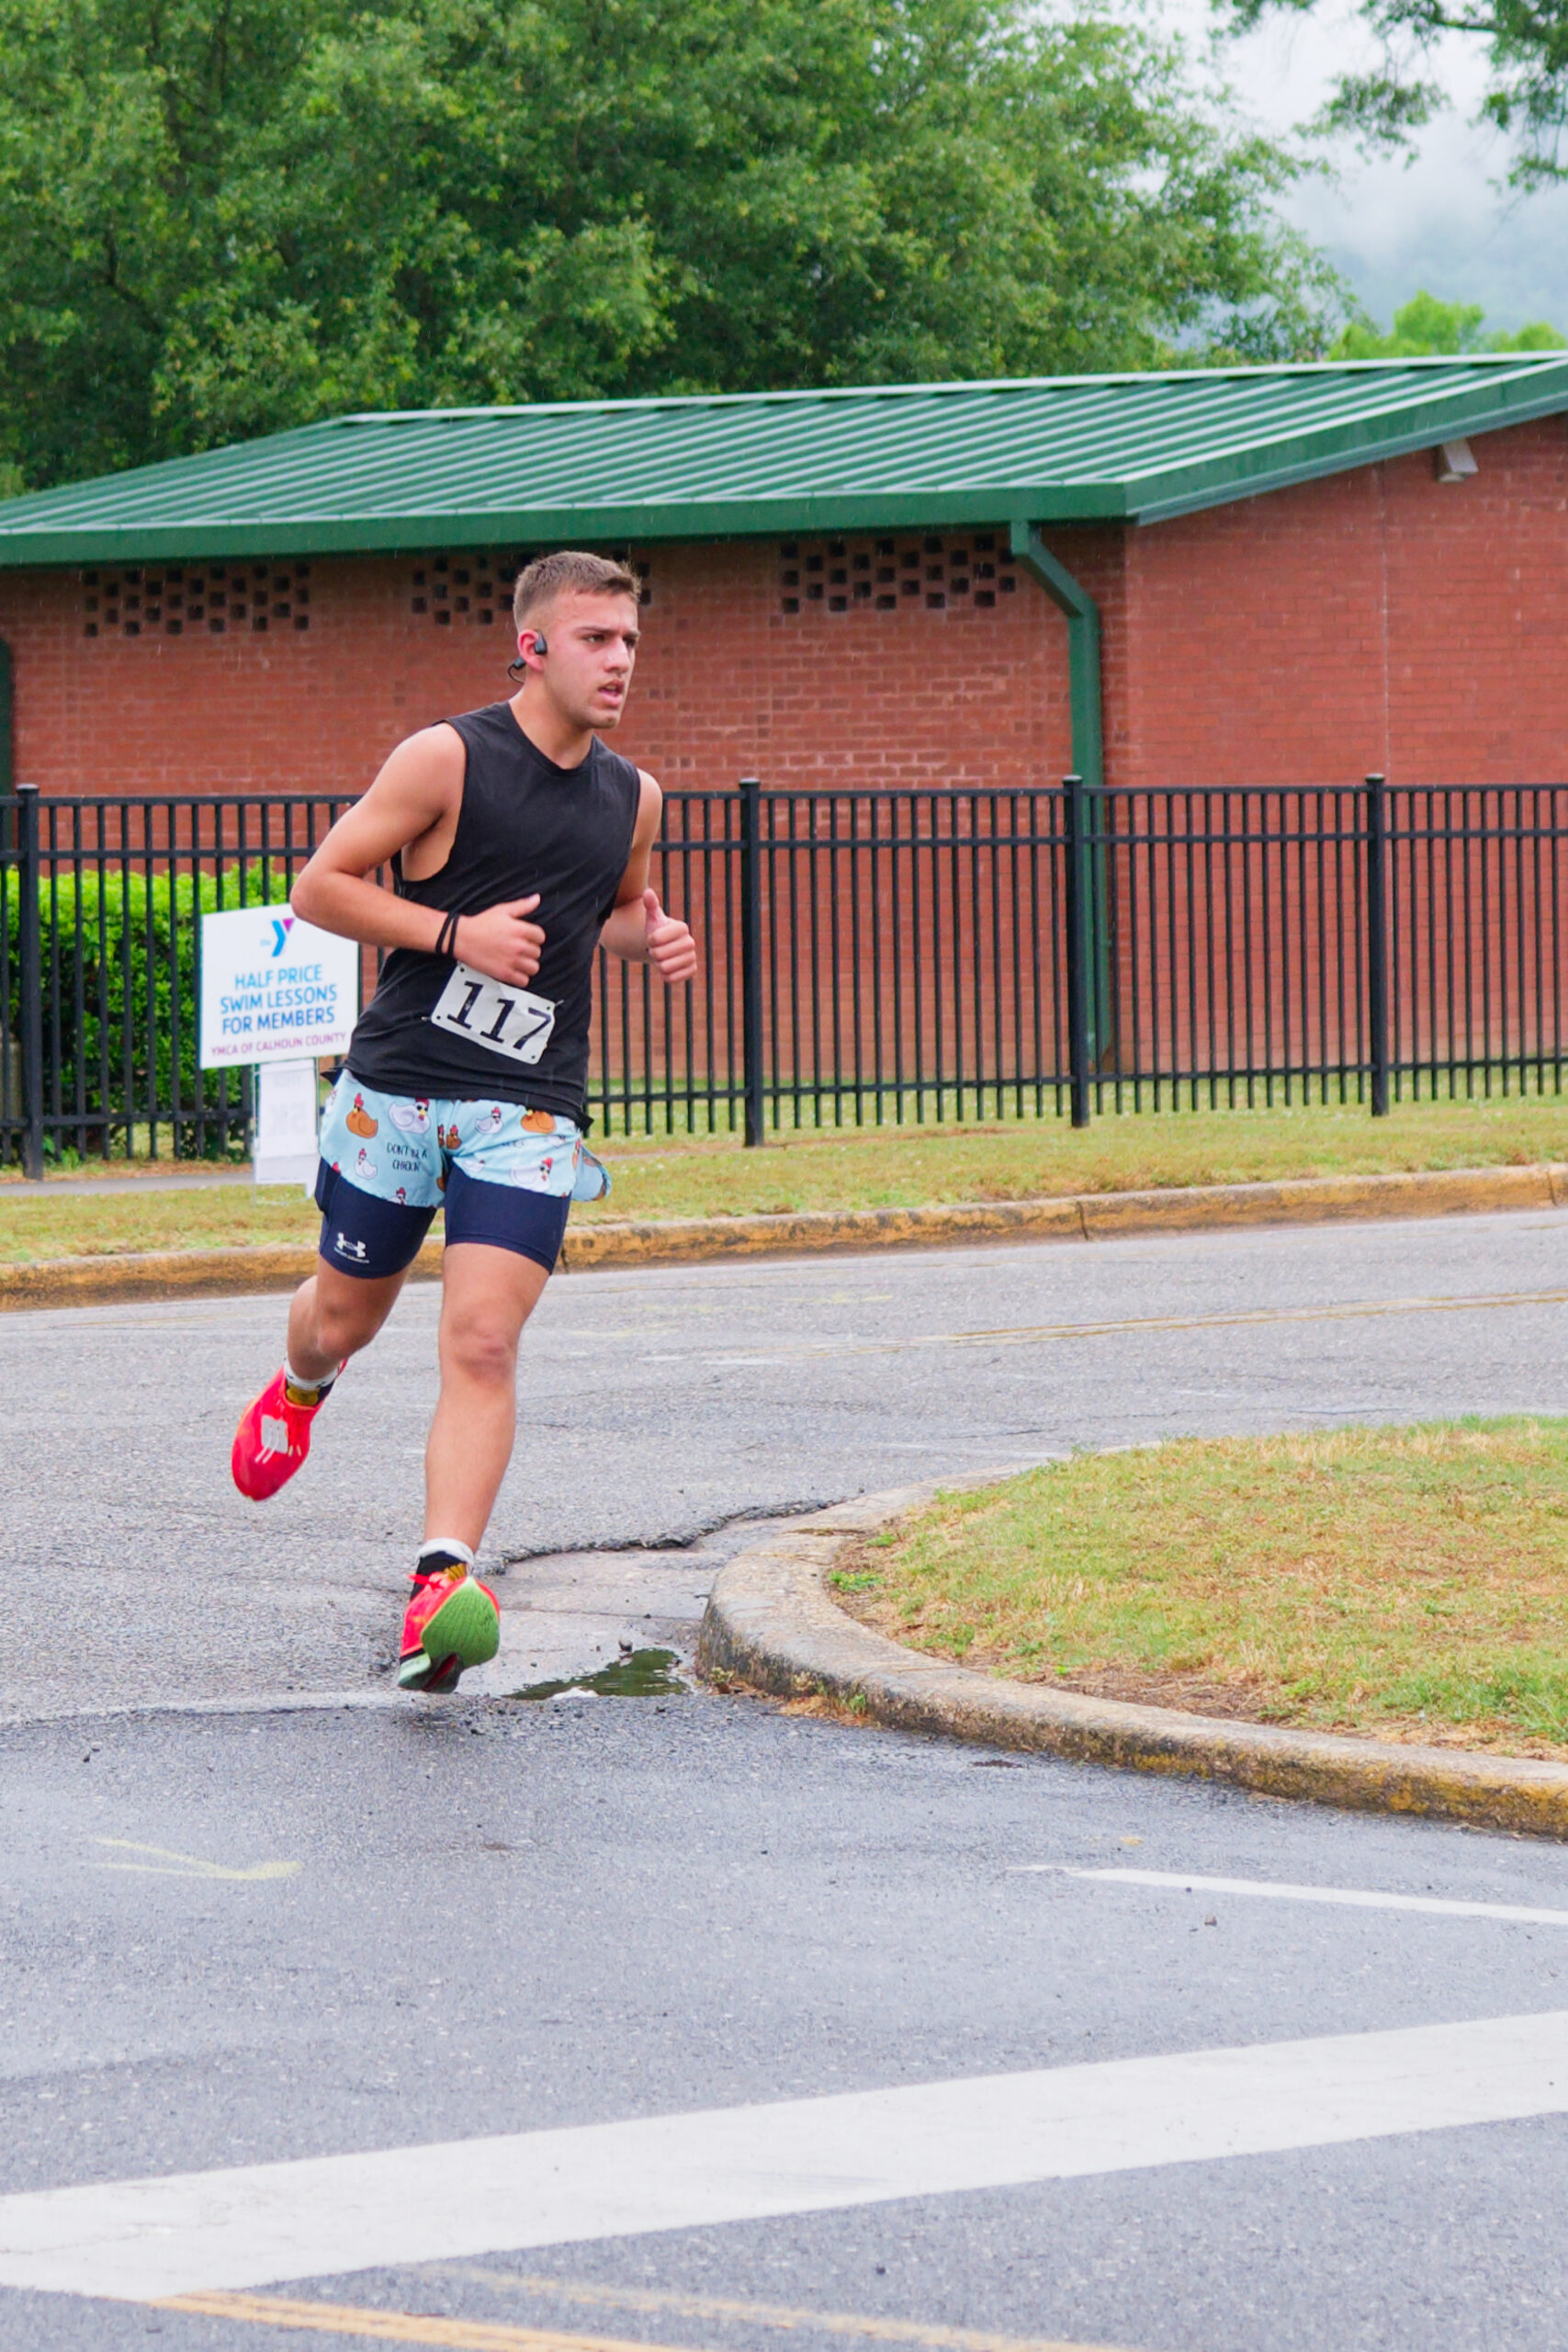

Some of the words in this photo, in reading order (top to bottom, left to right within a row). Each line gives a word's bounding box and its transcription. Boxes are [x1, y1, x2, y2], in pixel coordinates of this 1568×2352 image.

[234, 970, 273, 990] HALF
[277, 964, 322, 985] PRICE
[220, 994, 263, 1014] SWIM
[267, 984, 337, 1009] LESSONS
[222, 1016, 253, 1035] FOR
[257, 1006, 334, 1030] MEMBERS
[446, 980, 551, 1050] 117
[210, 1045, 238, 1057] YMCA
[241, 1043, 253, 1054] OF
[256, 1037, 302, 1052] CALHOUN
[306, 1032, 346, 1046] COUNTY
